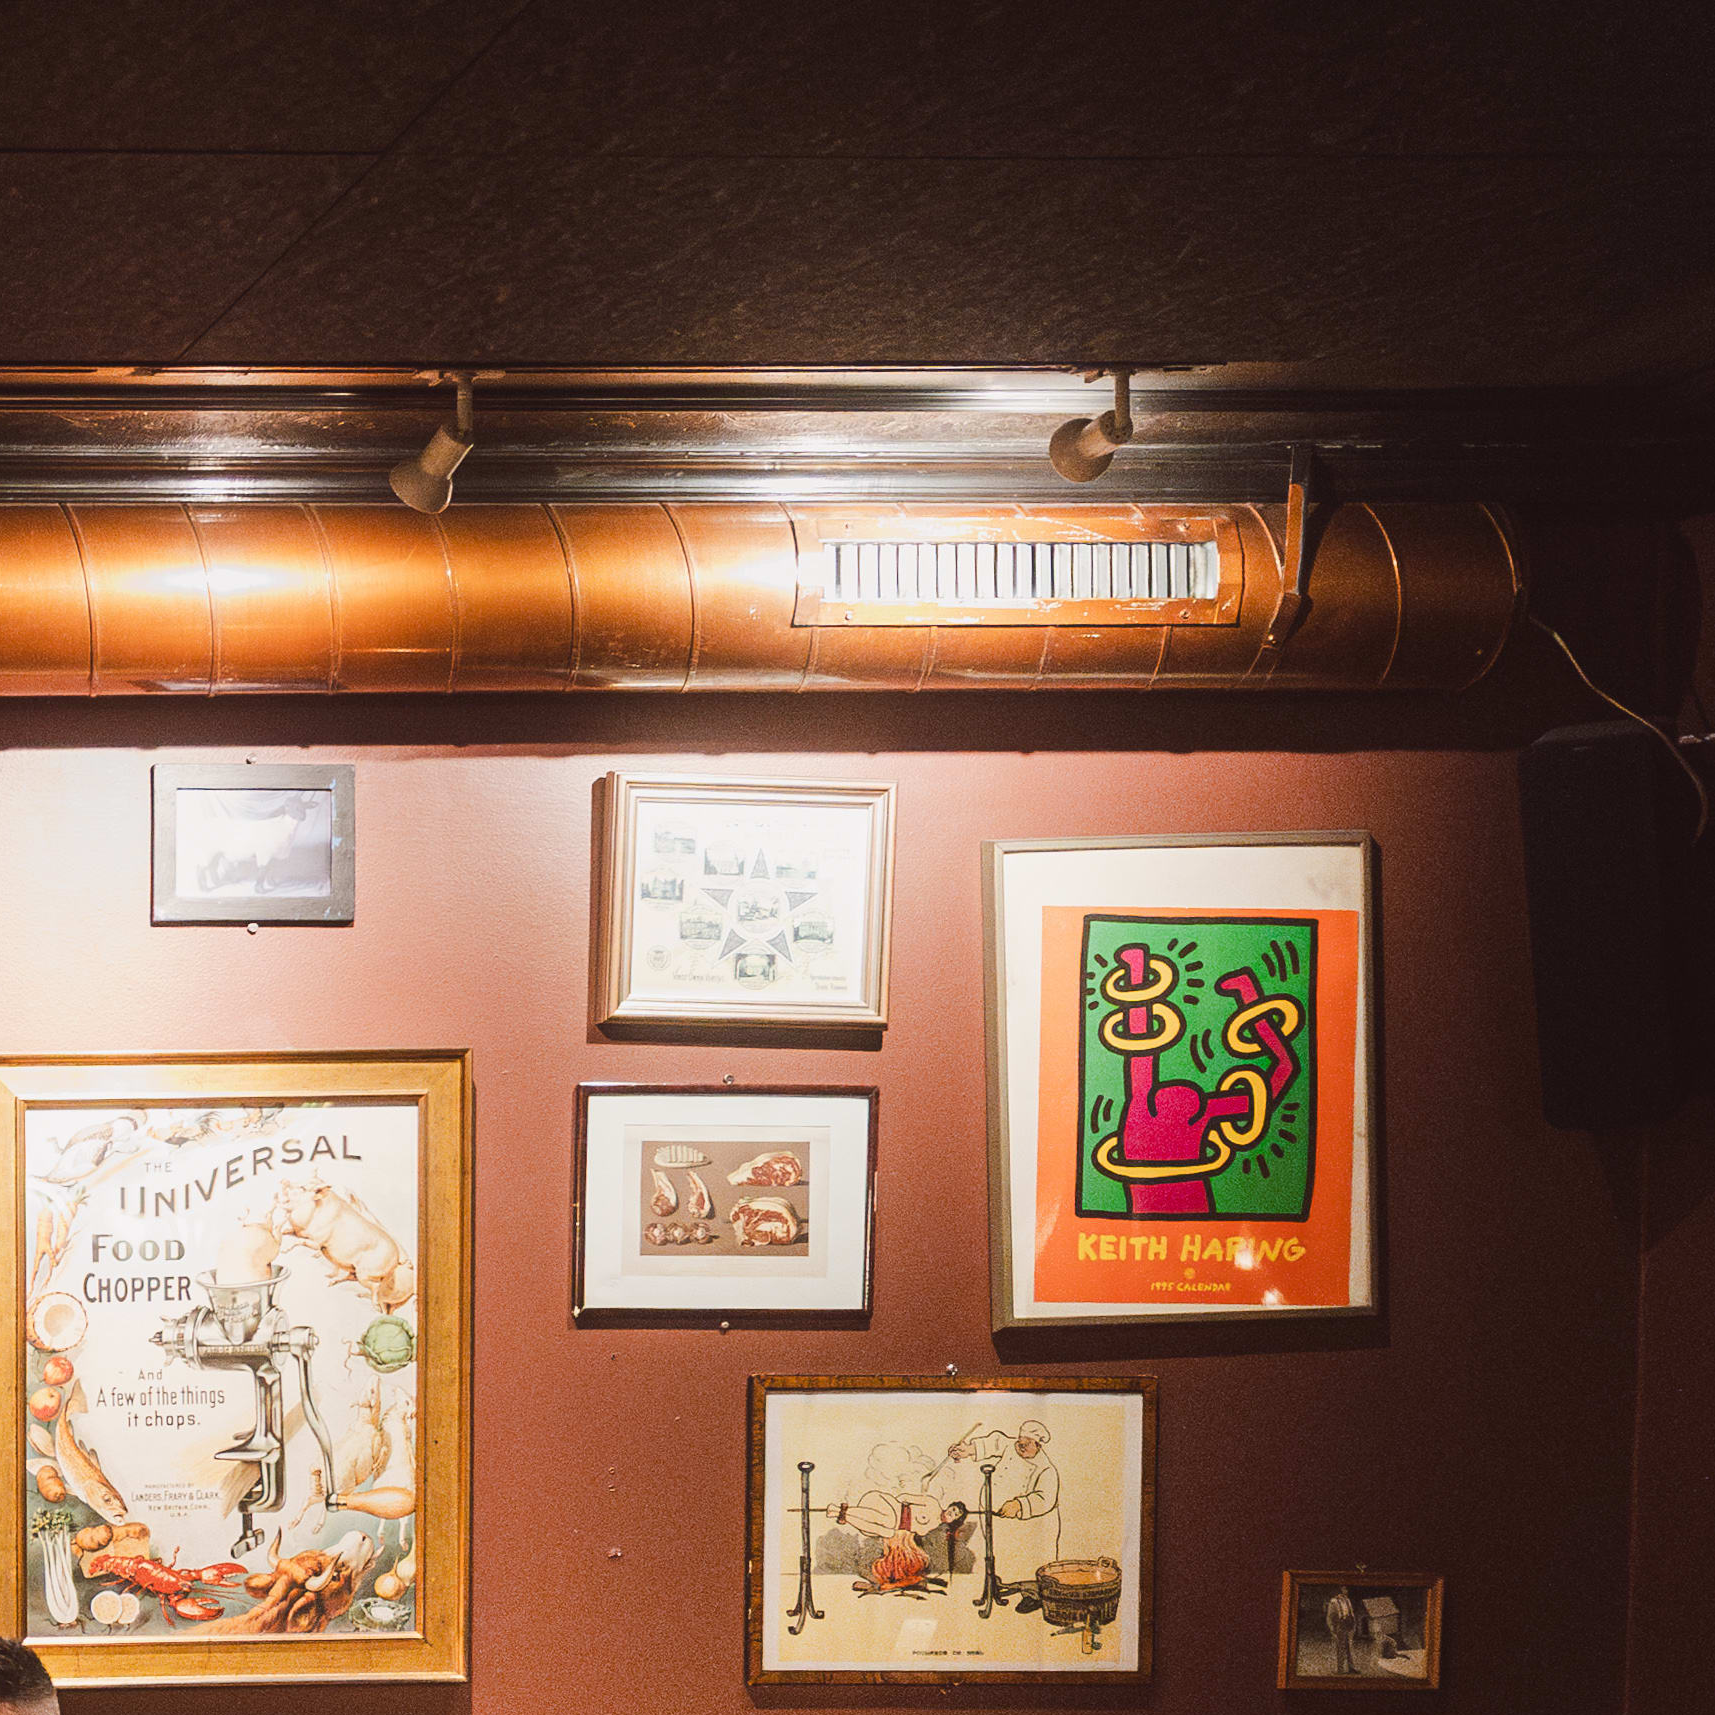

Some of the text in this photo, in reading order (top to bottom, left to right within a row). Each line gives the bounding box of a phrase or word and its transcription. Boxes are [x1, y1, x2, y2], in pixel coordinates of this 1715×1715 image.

[119, 1134, 363, 1218] UNIVERSAL
[144, 1161, 172, 1173] THE
[1078, 1232, 1168, 1262] KEITH
[83, 1273, 192, 1303] CHOPPER
[1150, 1282, 1232, 1292] 1995 CALENDAR
[137, 1368, 163, 1381] And
[96, 1385, 226, 1408] A few of the things
[127, 1410, 201, 1429] it chops.
